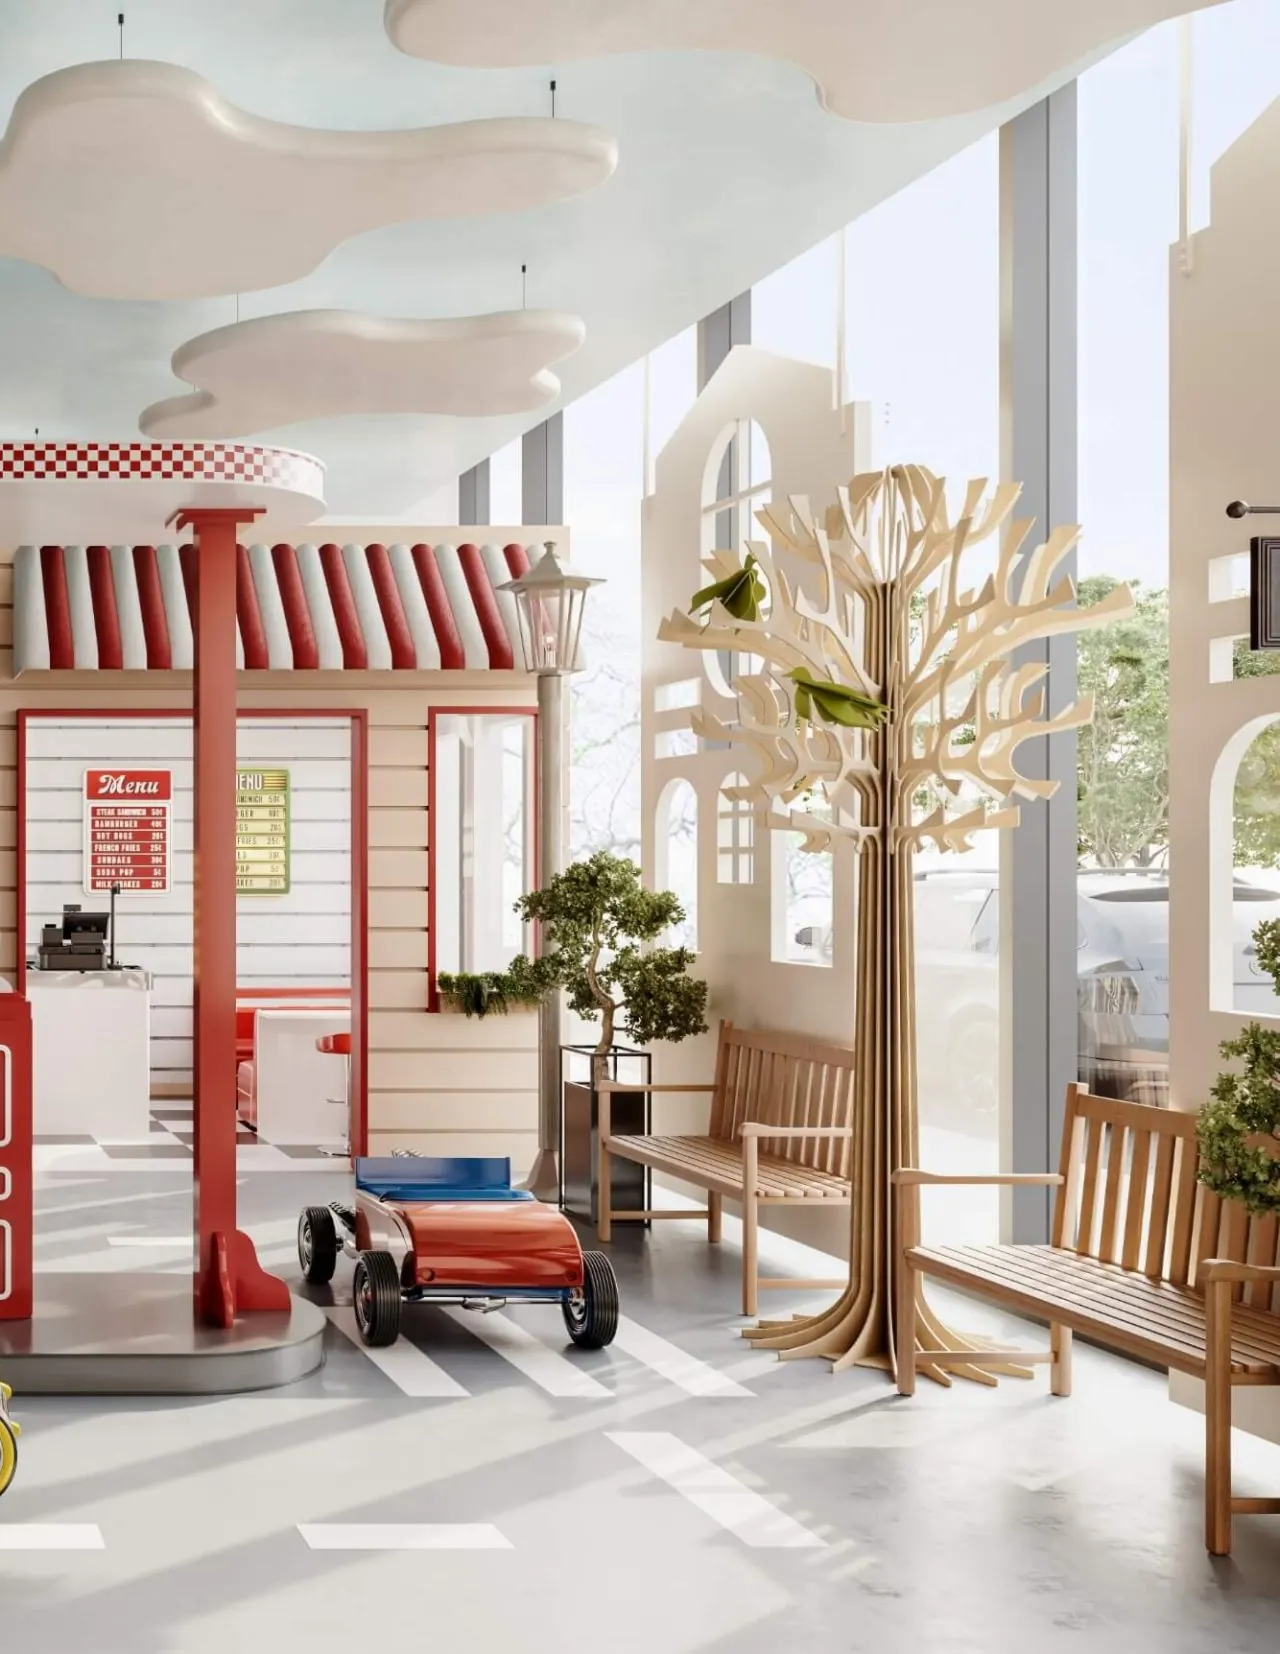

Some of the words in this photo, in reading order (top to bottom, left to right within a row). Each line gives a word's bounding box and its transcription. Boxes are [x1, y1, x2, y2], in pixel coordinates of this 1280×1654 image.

[97, 774, 160, 794] Menu
[236, 773, 262, 790] ENU
[119, 868, 134, 876] POP
[95, 880, 112, 888] MILK
[114, 880, 140, 888] HAKES
